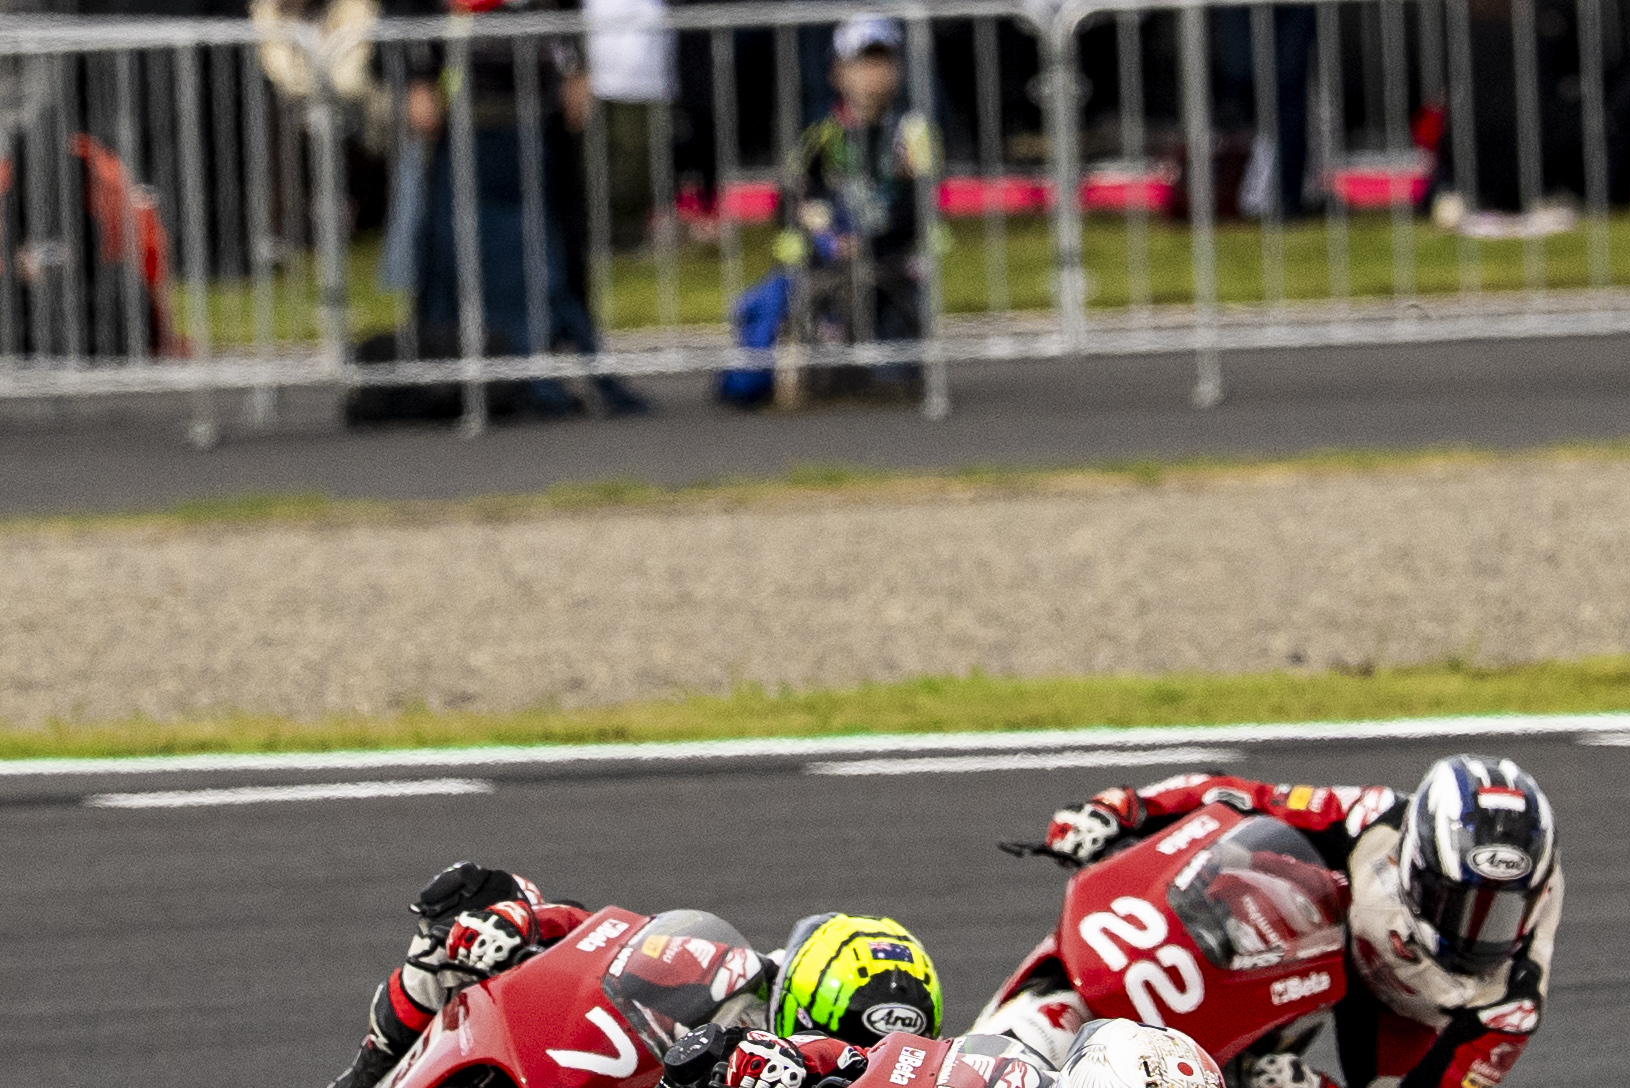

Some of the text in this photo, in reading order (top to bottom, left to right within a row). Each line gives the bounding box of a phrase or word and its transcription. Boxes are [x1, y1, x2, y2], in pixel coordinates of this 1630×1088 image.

[1472, 850, 1525, 870] Arai
[1079, 896, 1204, 1028] 22
[872, 1008, 919, 1029] Arai
[545, 1006, 638, 1077] 7
[889, 1054, 925, 1086] Beta
